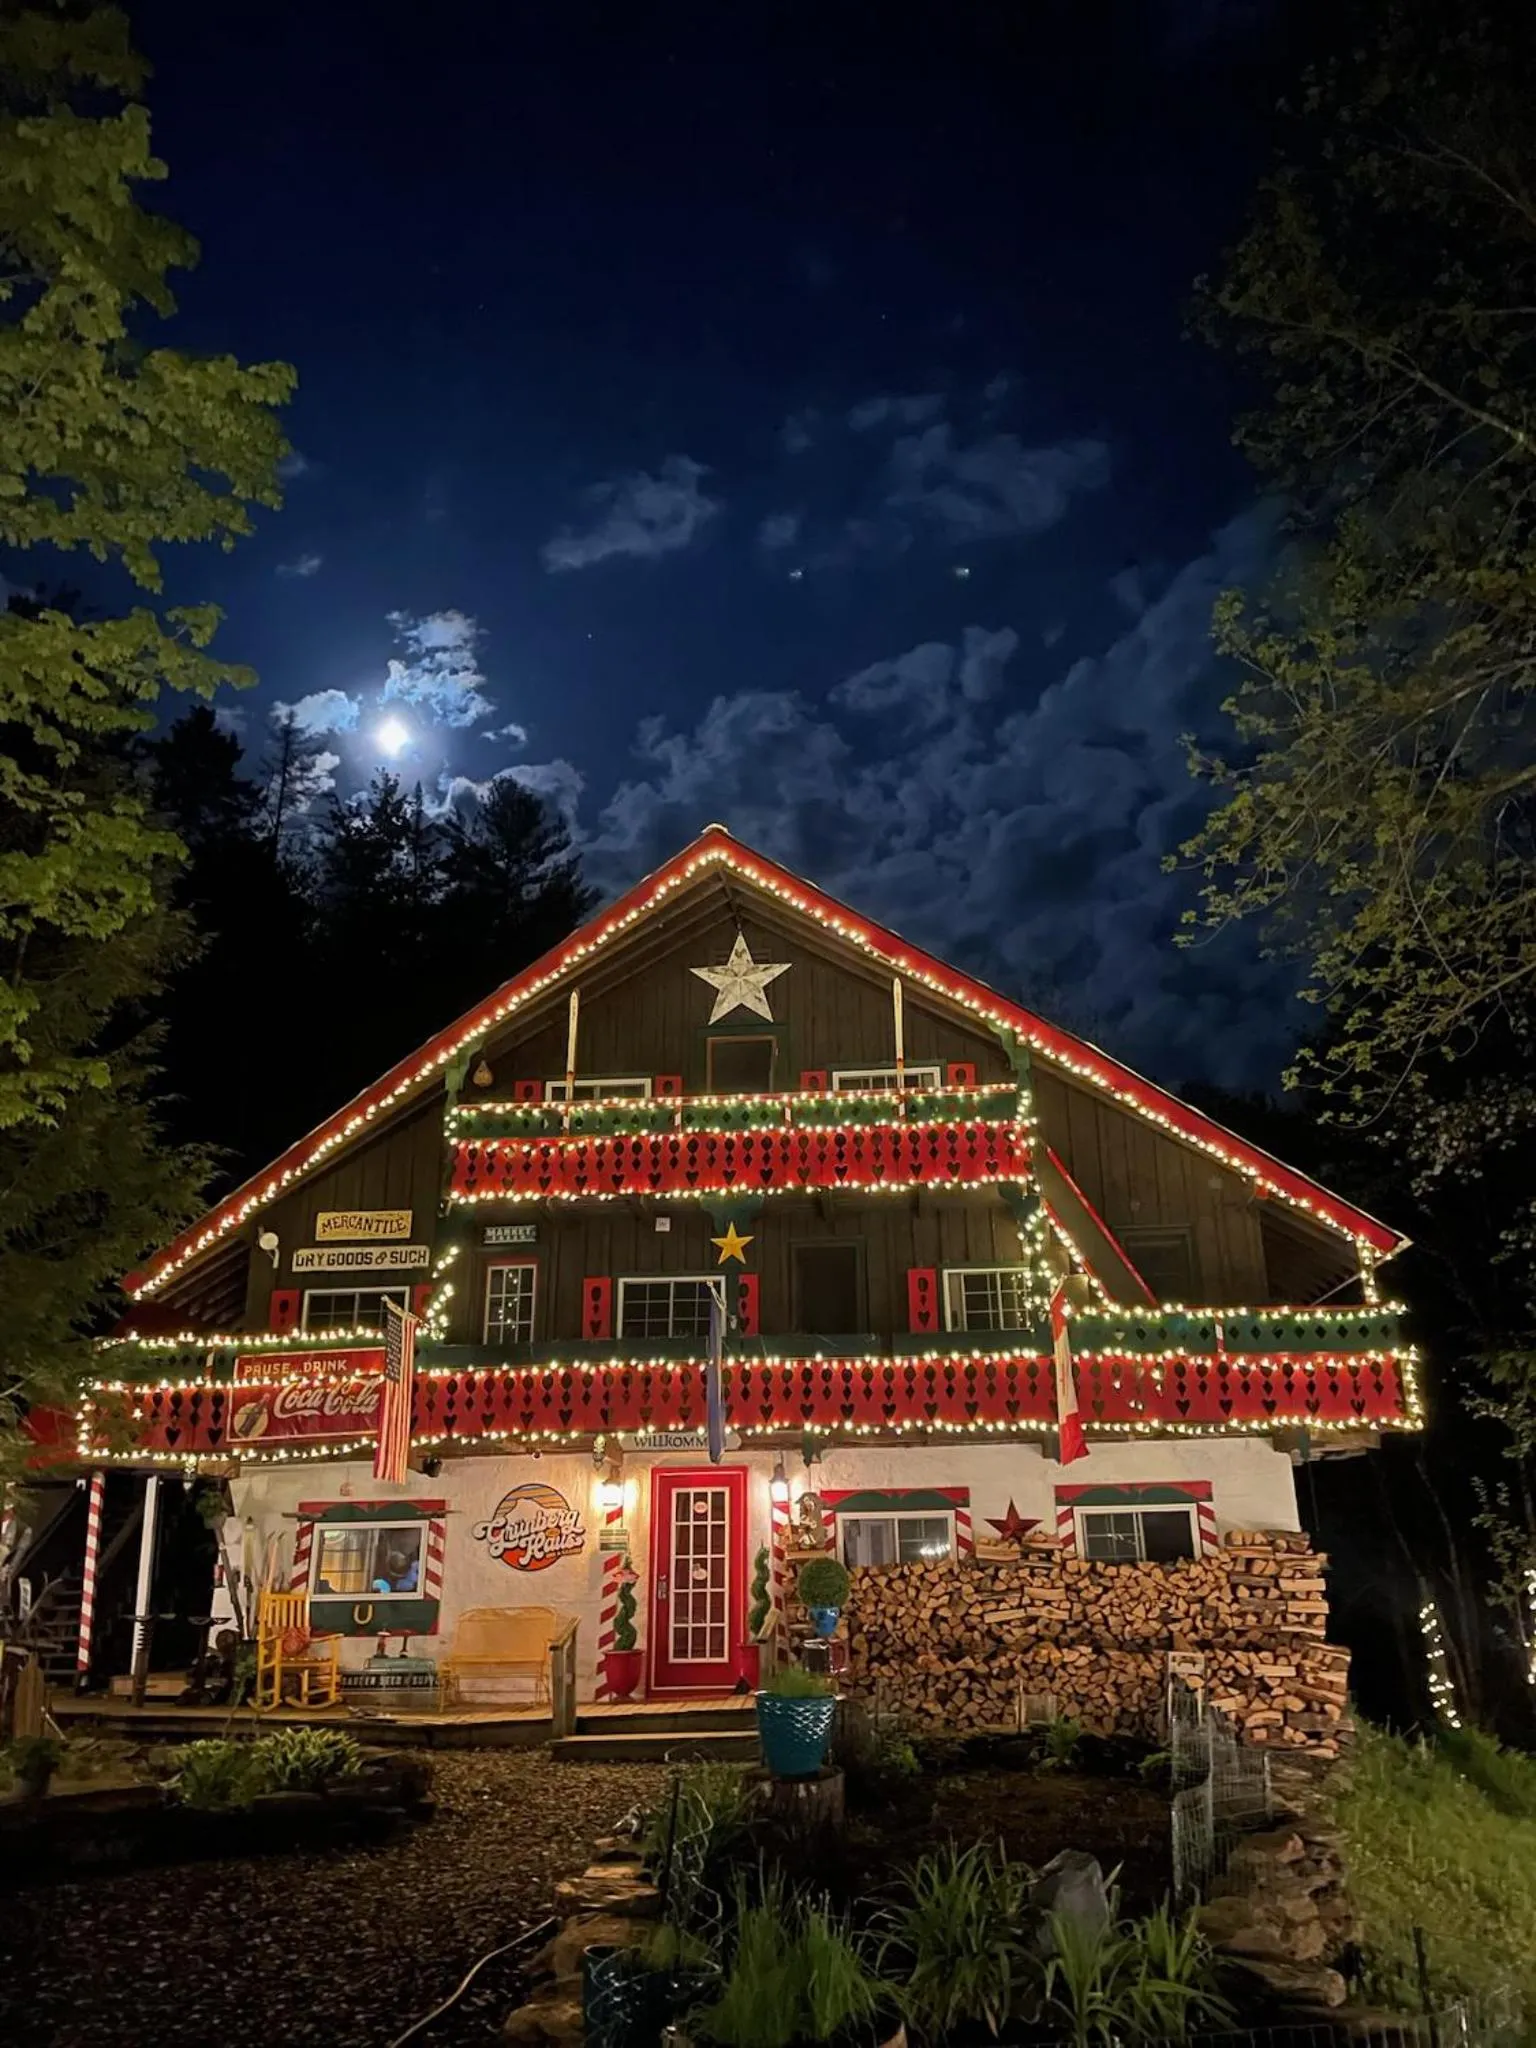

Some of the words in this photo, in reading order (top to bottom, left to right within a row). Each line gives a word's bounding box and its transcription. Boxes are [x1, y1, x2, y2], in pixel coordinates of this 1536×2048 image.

[321, 1214, 406, 1234] MERCANTILE
[296, 1253, 325, 1267] DRY
[327, 1251, 373, 1266] GOODS
[390, 1249, 427, 1264] SUCH
